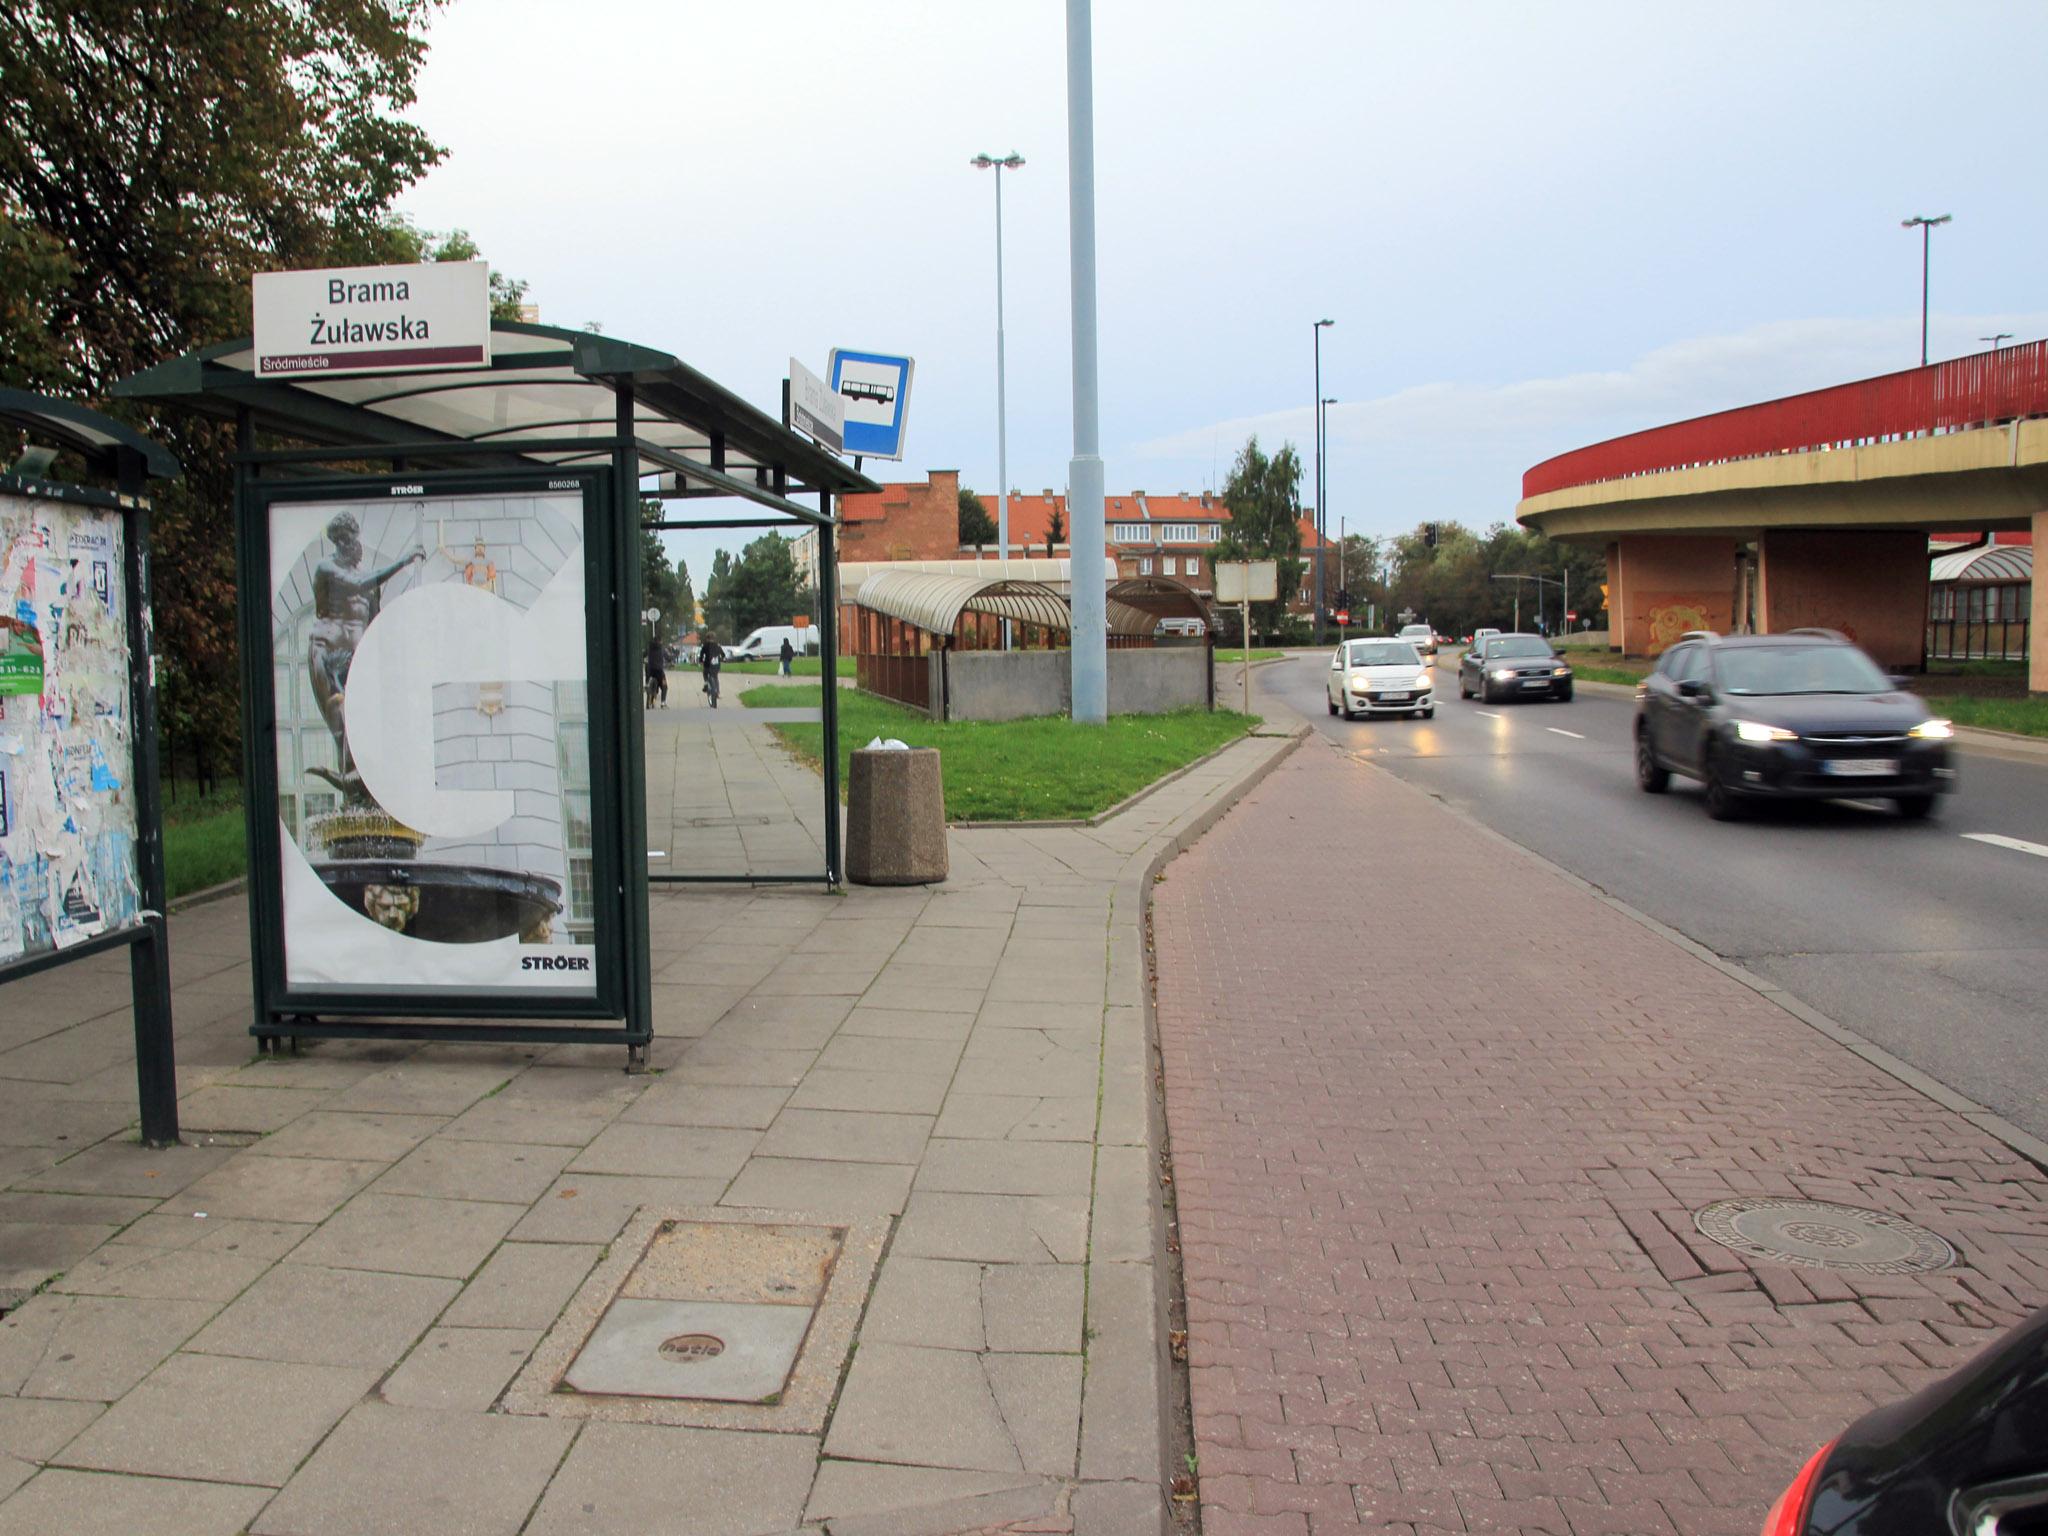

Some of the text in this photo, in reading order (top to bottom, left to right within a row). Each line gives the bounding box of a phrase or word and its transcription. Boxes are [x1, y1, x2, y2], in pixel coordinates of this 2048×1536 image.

[328, 279, 410, 304] Brama
[310, 312, 430, 345] Żuławska
[263, 355, 330, 371] Śródmieście
[391, 484, 424, 496] STRÖER
[521, 954, 590, 971] STRÖER
